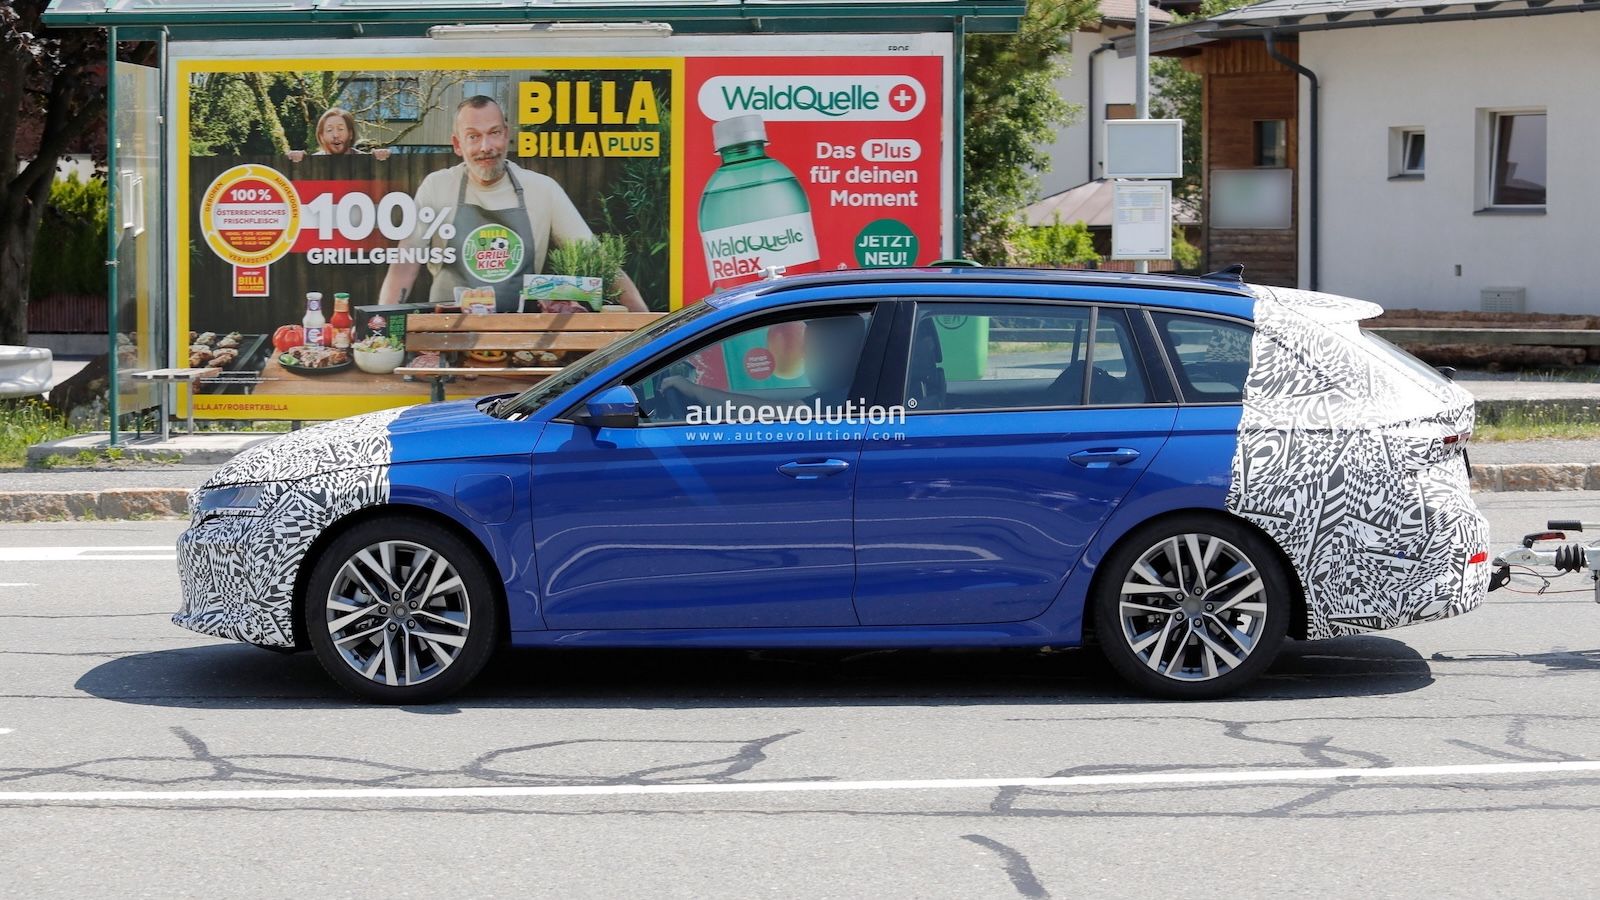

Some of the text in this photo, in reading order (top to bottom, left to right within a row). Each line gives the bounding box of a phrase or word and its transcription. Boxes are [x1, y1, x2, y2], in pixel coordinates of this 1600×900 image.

[518, 81, 660, 125] BILLA
[721, 84, 879, 116] WaldQuelle
[518, 131, 654, 157] BILLA PLUS
[816, 142, 912, 159] Das Plus
[810, 166, 918, 183] für deinen
[830, 190, 918, 207] Moment
[216, 208, 287, 216] ÖSTERREICHISCHES
[306, 191, 456, 241] 100%
[858, 235, 914, 248] JETZT
[307, 247, 456, 264] GRILLGENUSS
[476, 251, 509, 260] GRILL
[478, 260, 505, 268] KICK
[864, 251, 908, 265] NEU!
[712, 256, 762, 278] Relax
[237, 276, 265, 286] BILLA
